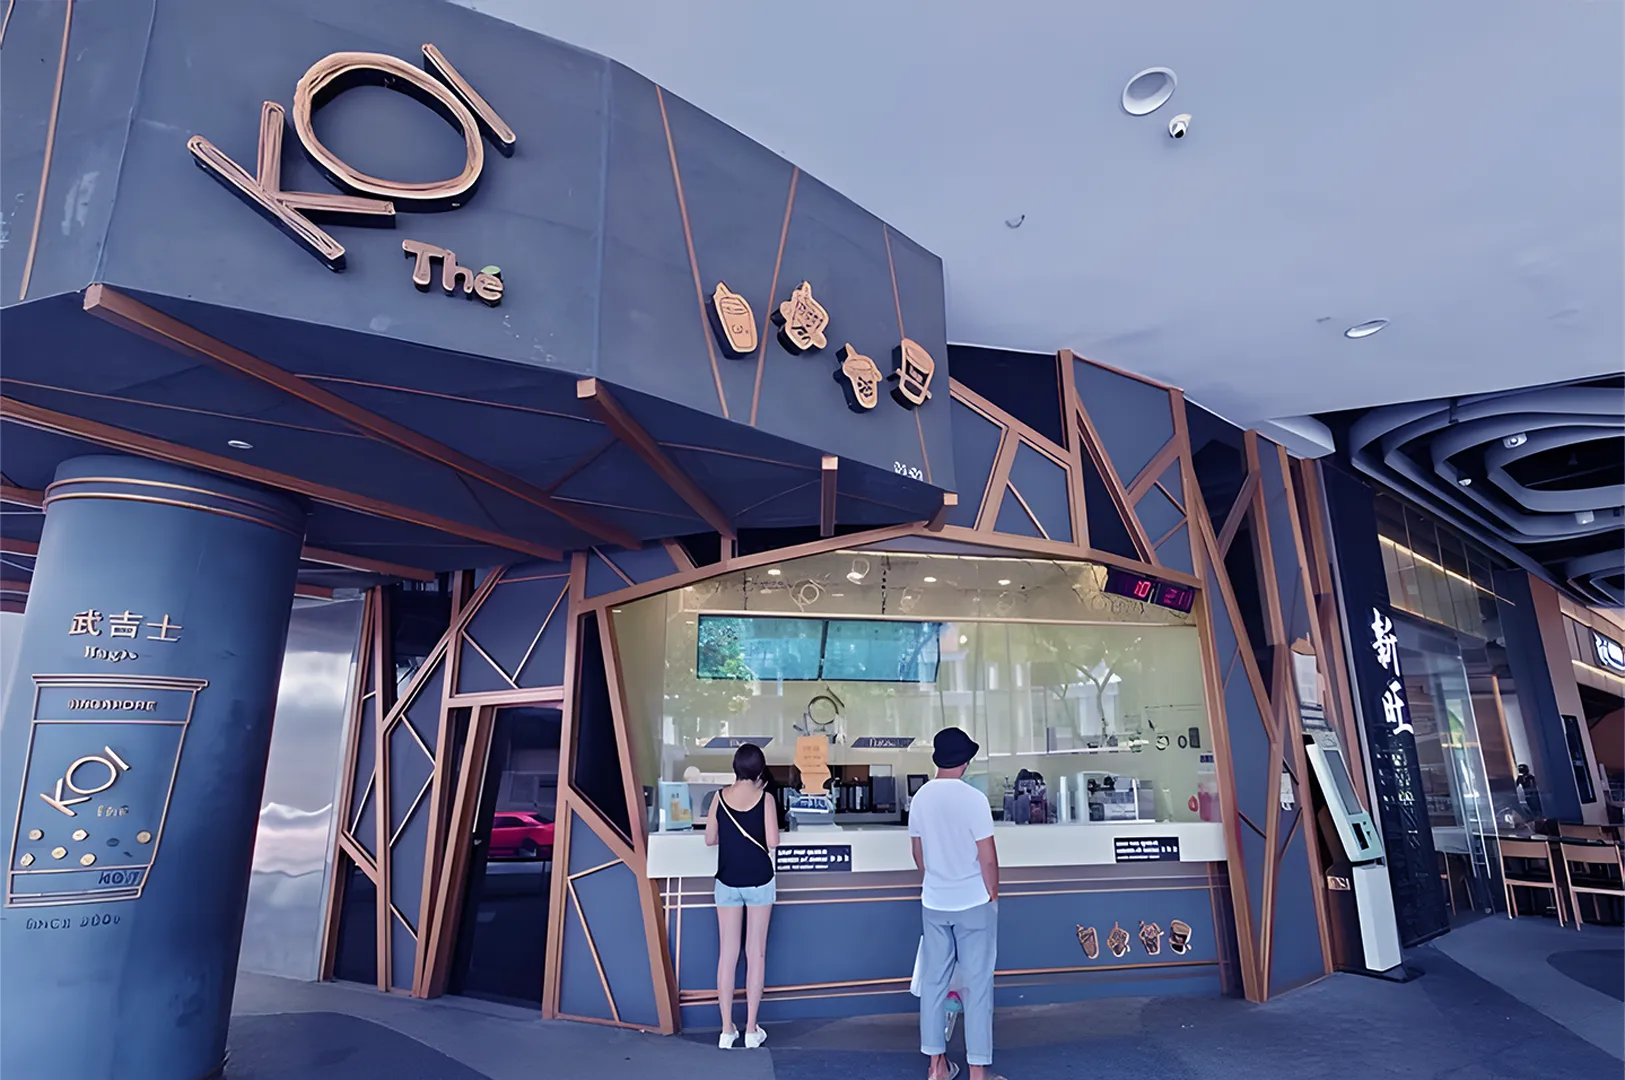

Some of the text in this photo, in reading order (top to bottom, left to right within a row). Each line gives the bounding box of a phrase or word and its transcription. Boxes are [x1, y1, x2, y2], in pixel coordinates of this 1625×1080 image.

[187, 43, 516, 268] KOI
[68, 608, 184, 642] 武吉士
[1371, 607, 1414, 735] 新旺
[40, 745, 131, 816] KOI
